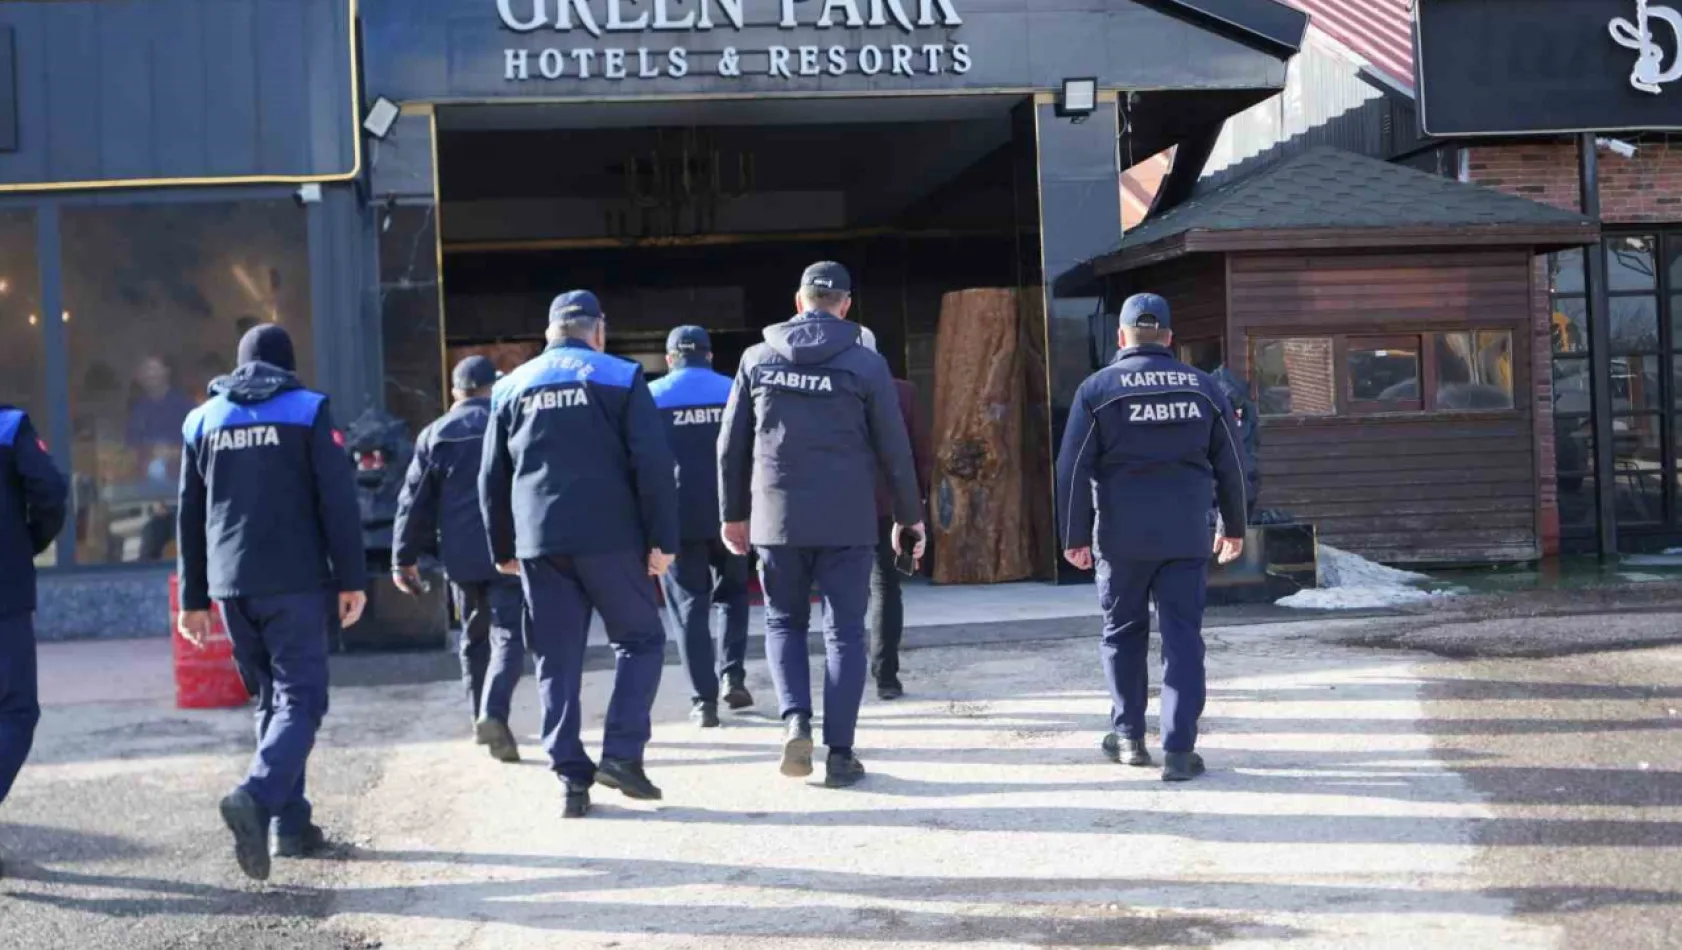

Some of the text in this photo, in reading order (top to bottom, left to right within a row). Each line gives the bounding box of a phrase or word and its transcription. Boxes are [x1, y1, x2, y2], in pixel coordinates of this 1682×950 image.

[503, 44, 972, 79] HOTELS & RESORTS
[760, 370, 833, 392] ZABITA
[1120, 371, 1200, 387] KARTEPE
[520, 387, 589, 415] ZABITA
[1129, 401, 1202, 421] ZABITA
[673, 408, 723, 425] ZABIT
